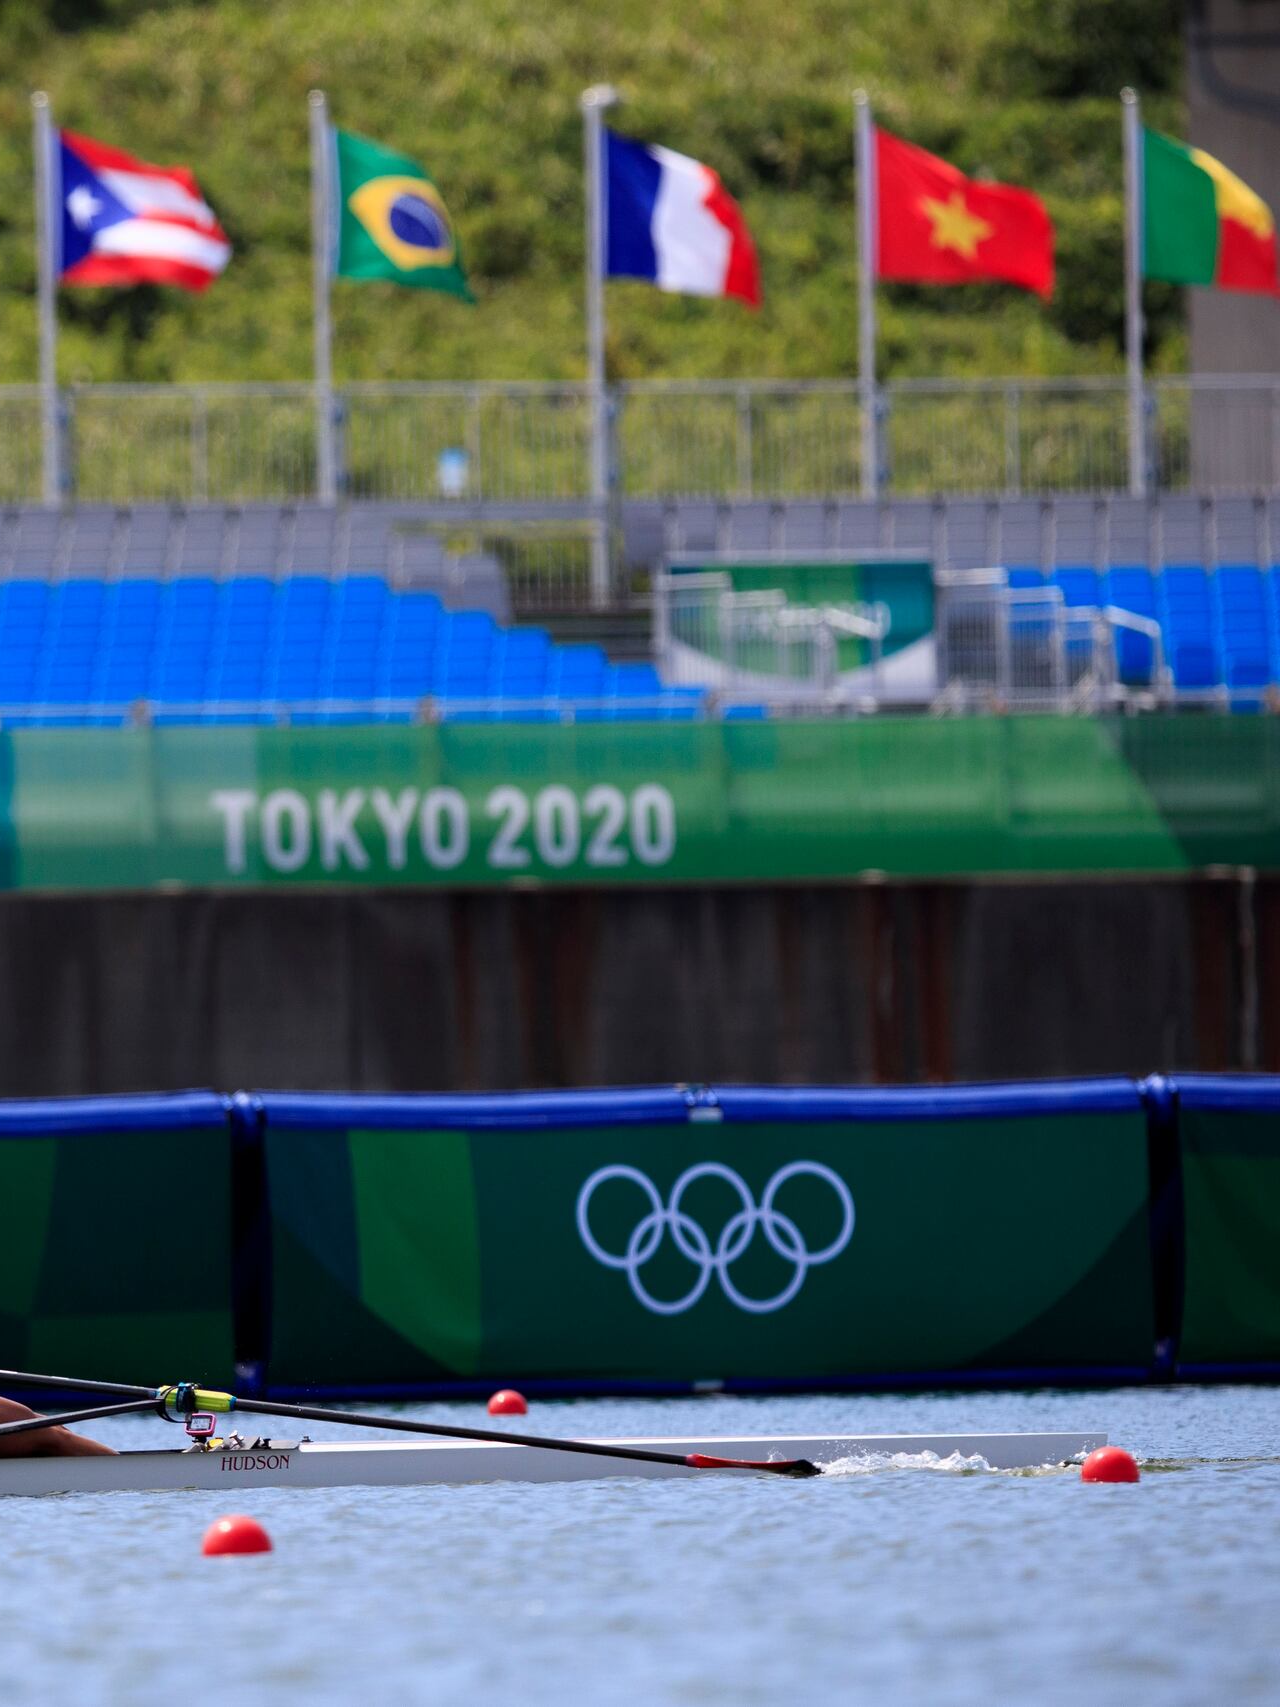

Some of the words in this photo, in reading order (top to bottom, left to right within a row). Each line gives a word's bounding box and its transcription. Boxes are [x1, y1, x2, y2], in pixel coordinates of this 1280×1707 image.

[213, 787, 469, 873] TOKYO
[485, 784, 675, 868] 2020
[222, 1455, 290, 1471] HUDSON
